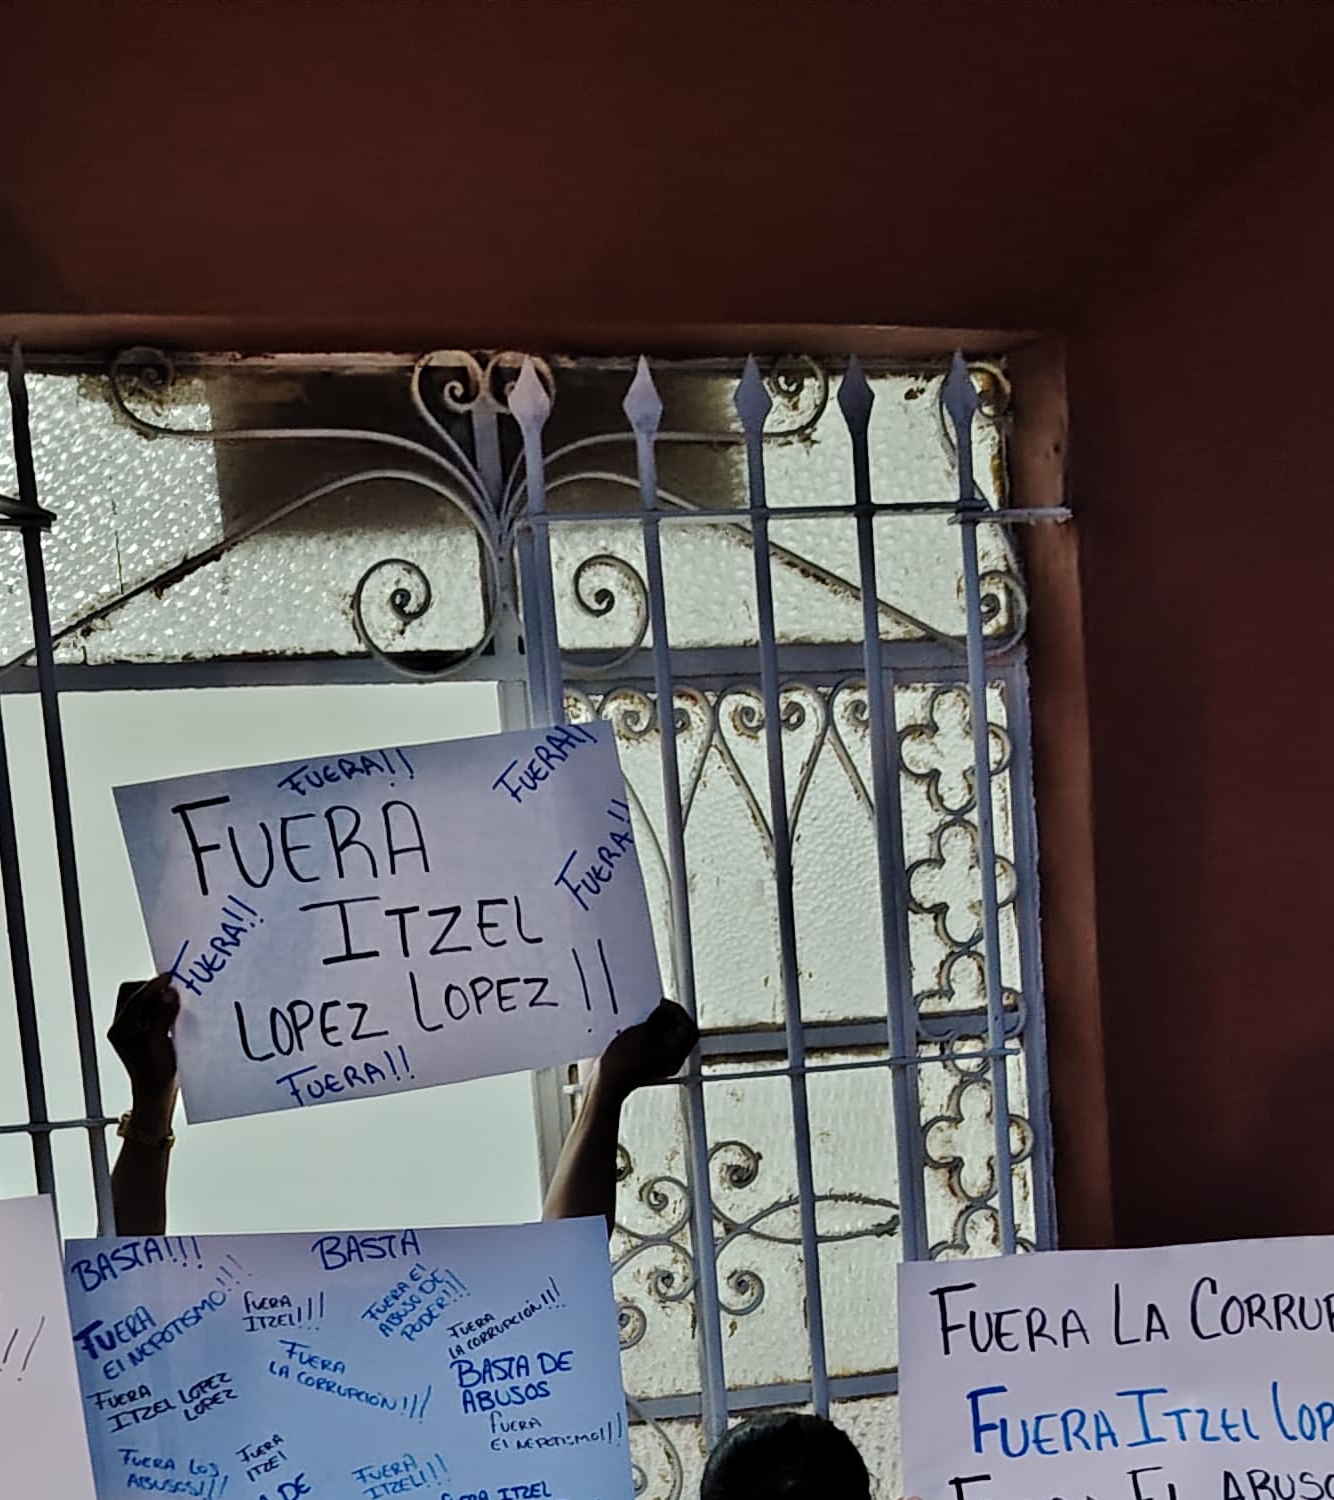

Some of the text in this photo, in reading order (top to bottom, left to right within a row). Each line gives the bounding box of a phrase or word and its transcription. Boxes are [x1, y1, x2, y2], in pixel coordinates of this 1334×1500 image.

[277, 746, 417, 798] FUERA!!
[492, 724, 598, 804] FUERA!!
[171, 794, 431, 897] FUERA
[554, 798, 635, 912] FUERA!!
[170, 895, 265, 997] FUERA!!
[300, 894, 544, 966] ITZEL
[233, 998, 389, 1063] LOPEZ
[276, 1045, 416, 1107] FUERA!!
[71, 1235, 203, 1293] BASTA!!!
[310, 1228, 422, 1271] BASTA
[360, 1281, 411, 1321] FUERA
[377, 1267, 446, 1339] ABUSO DE
[929, 1282, 1090, 1357] FUERA
[1113, 1283, 1170, 1348] LA
[72, 1305, 157, 1360] FUERA
[446, 1312, 497, 1339] FUERA
[268, 1360, 290, 1379] LA
[278, 1339, 347, 1375] FUERA
[448, 1344, 466, 1360] LA
[449, 1350, 574, 1390] BASTA DE
[85, 1384, 153, 1411] FUERA
[177, 1372, 233, 1405] LOPEZ
[182, 1388, 239, 1422] LOPEZ
[462, 1380, 552, 1415] ABUSOS
[967, 1385, 1120, 1459] FUERA
[117, 1448, 176, 1471] FUERA
[234, 1432, 285, 1463] FUERA
[350, 1452, 418, 1484] FUERA
